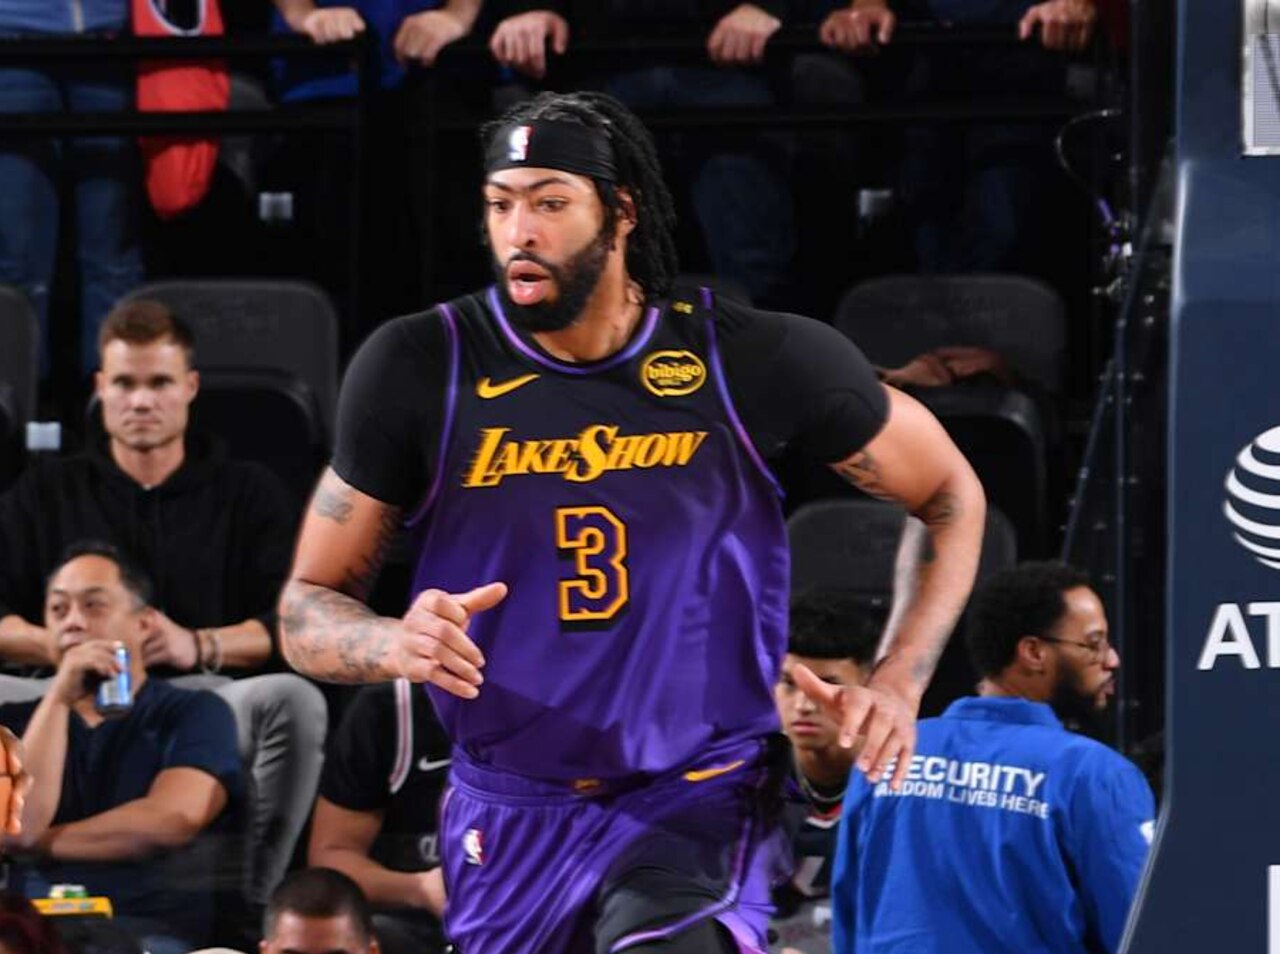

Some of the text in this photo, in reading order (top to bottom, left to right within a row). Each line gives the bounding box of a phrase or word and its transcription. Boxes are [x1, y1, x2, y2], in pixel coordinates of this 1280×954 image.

[556, 506, 628, 622] 3
[948, 786, 997, 807] LIVES
[1000, 794, 1050, 820] HERE
